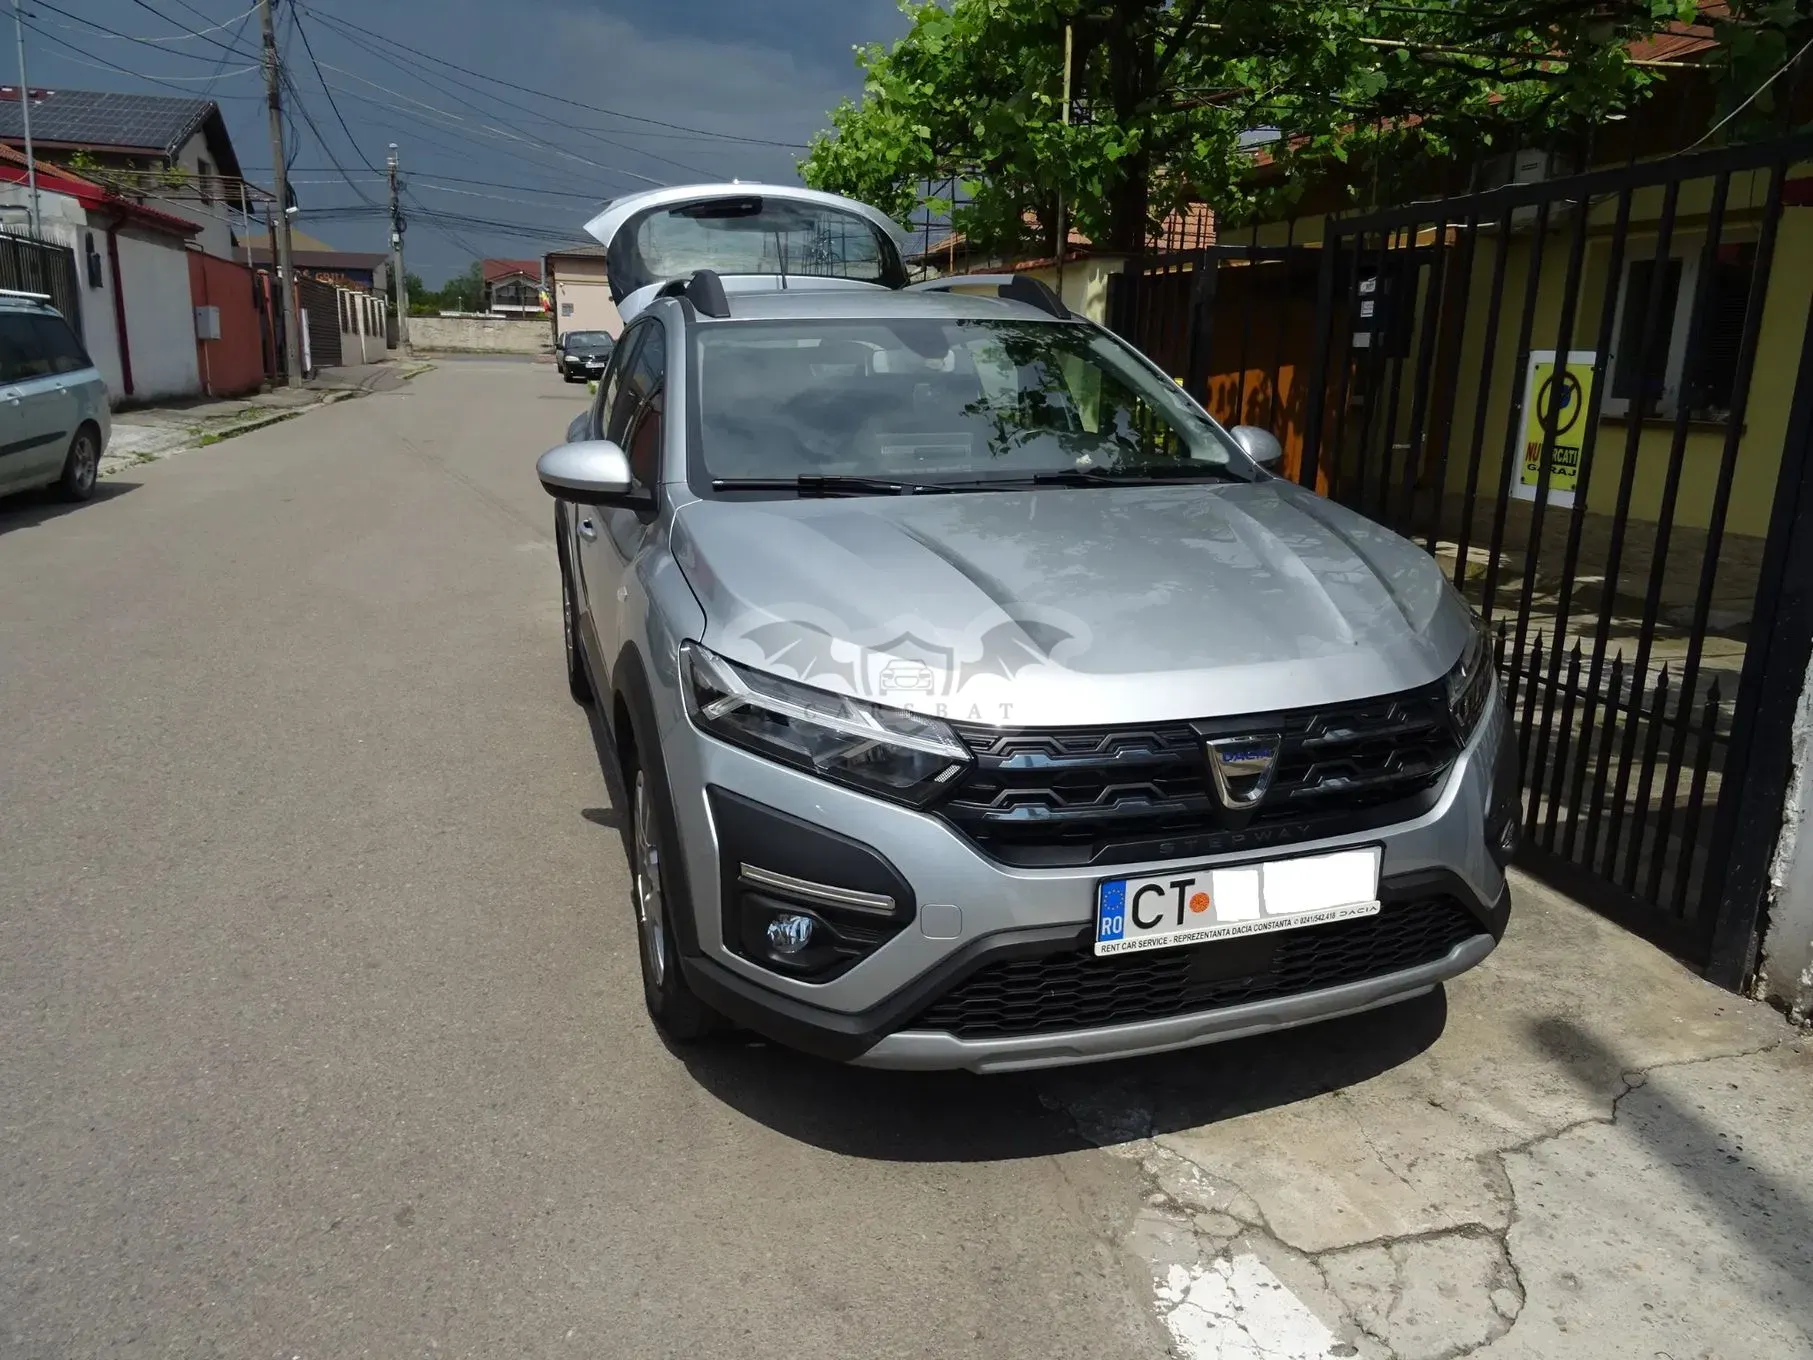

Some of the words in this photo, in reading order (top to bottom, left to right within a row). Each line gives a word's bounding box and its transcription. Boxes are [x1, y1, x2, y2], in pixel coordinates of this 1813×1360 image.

[1525, 442, 1541, 462] NU
[1545, 446, 1578, 465] RCATI
[1527, 463, 1577, 477] GRAJ
[1159, 825, 1310, 854] STEPWAY
[1131, 877, 1196, 930] CT
[1339, 905, 1377, 917] DACIA
[1100, 943, 1120, 953] RENT
[1121, 941, 1137, 950] CAR
[1138, 937, 1168, 949] SERVICE
[1173, 928, 1230, 944] REPREZENTANTA
[1232, 925, 1252, 936] DACIA
[1254, 919, 1292, 932] CONSTANTA
[1101, 915, 1122, 936] RO
